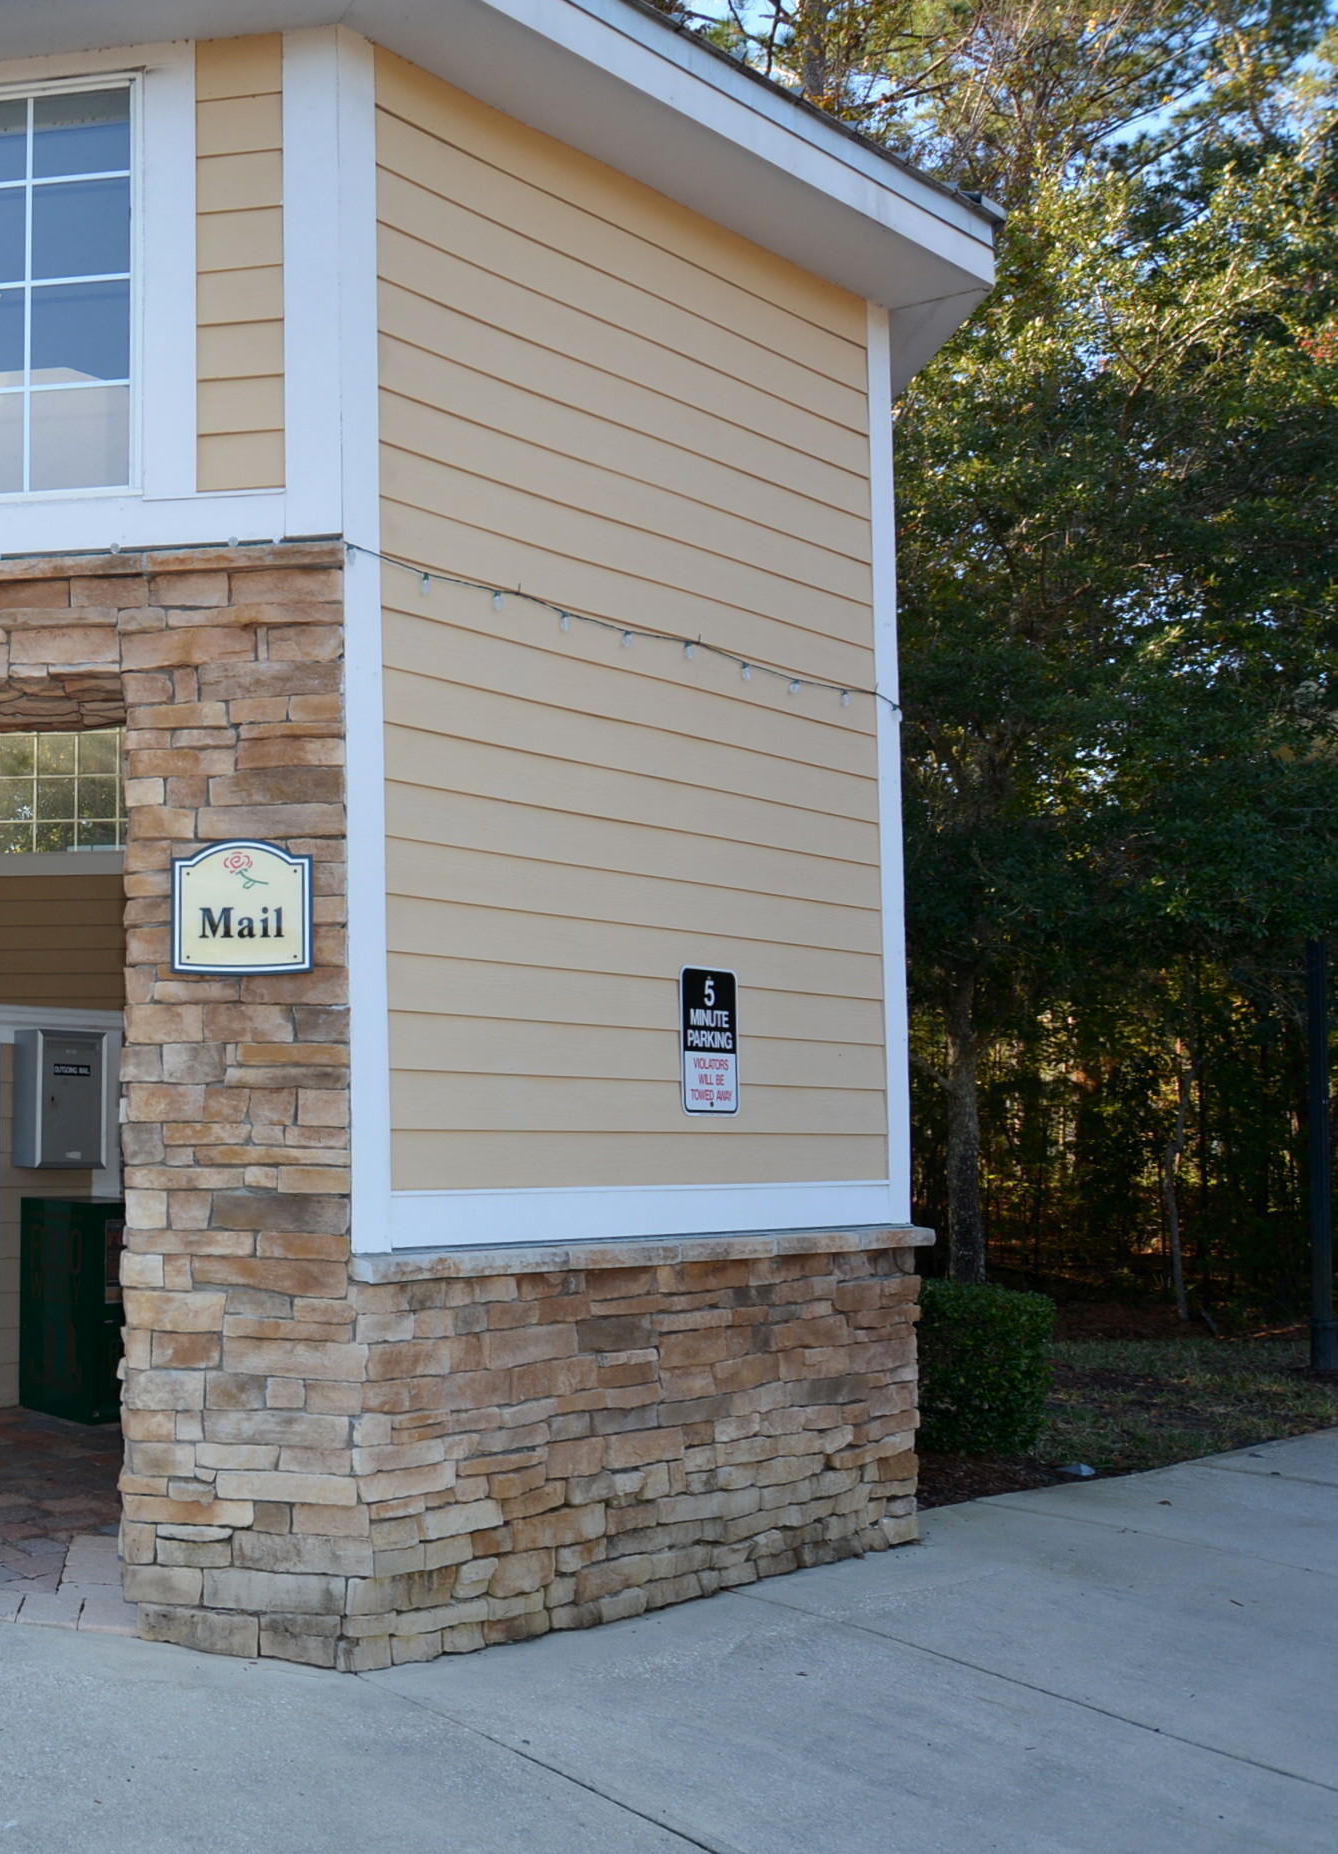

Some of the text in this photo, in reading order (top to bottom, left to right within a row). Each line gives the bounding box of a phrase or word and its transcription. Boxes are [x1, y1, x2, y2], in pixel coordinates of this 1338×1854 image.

[198, 906, 285, 939] Mail
[703, 980, 715, 1007] 5
[689, 1008, 729, 1028] MINUTE
[687, 1029, 733, 1049] PARKING
[54, 1065, 89, 1074] OUTGOING MAIL
[693, 1057, 729, 1071] VIOLATORS
[698, 1073, 725, 1086] WILL BE
[690, 1088, 733, 1102] TOWED AWAY
